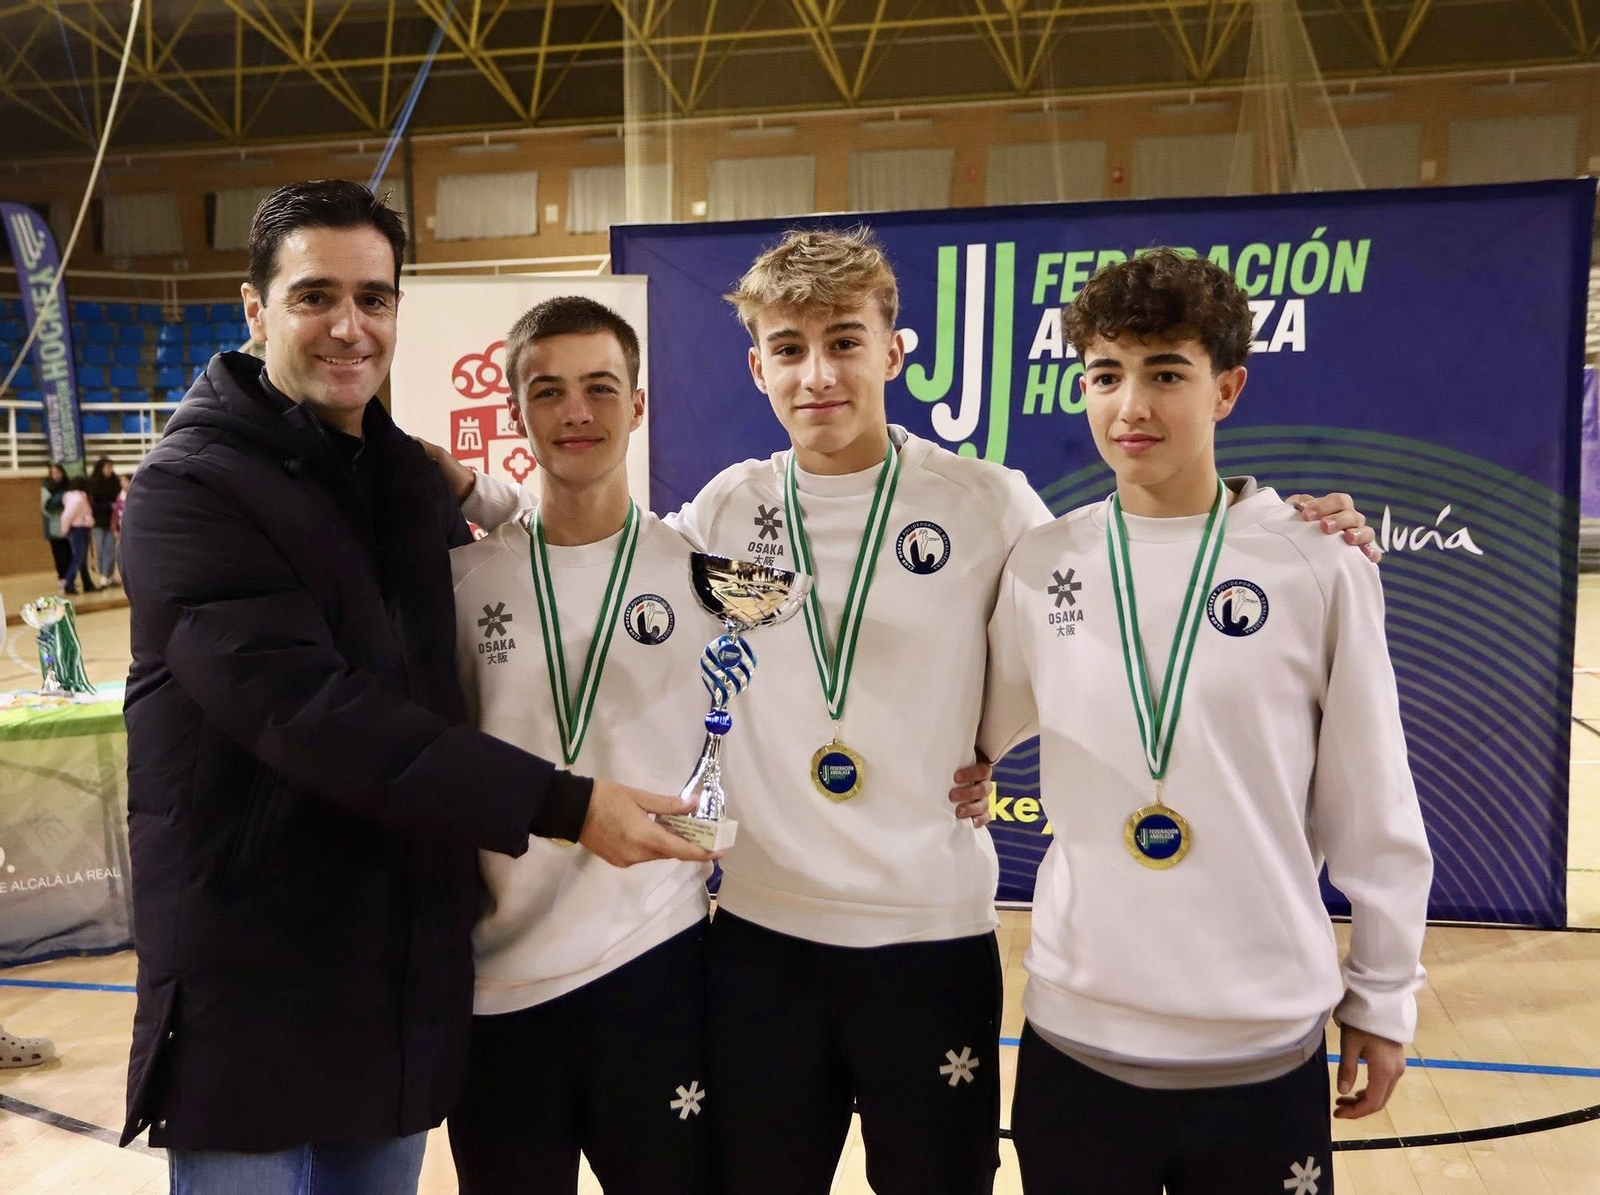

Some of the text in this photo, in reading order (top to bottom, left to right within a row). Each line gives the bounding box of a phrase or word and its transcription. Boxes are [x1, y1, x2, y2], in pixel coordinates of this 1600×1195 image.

[1032, 226, 1371, 305] FEACIÓN
[1373, 503, 1484, 556] lucía
[747, 541, 784, 556] OSAKA
[1216, 580, 1263, 596] POLIDEPORTIVO
[1048, 608, 1084, 625] OSAKA
[1056, 624, 1076, 637] 大阪
[478, 638, 516, 654] OSAKA
[486, 651, 509, 666] 大阪
[0, 881, 8, 893] E
[66, 871, 84, 885] LA
[86, 867, 122, 882] REAL
